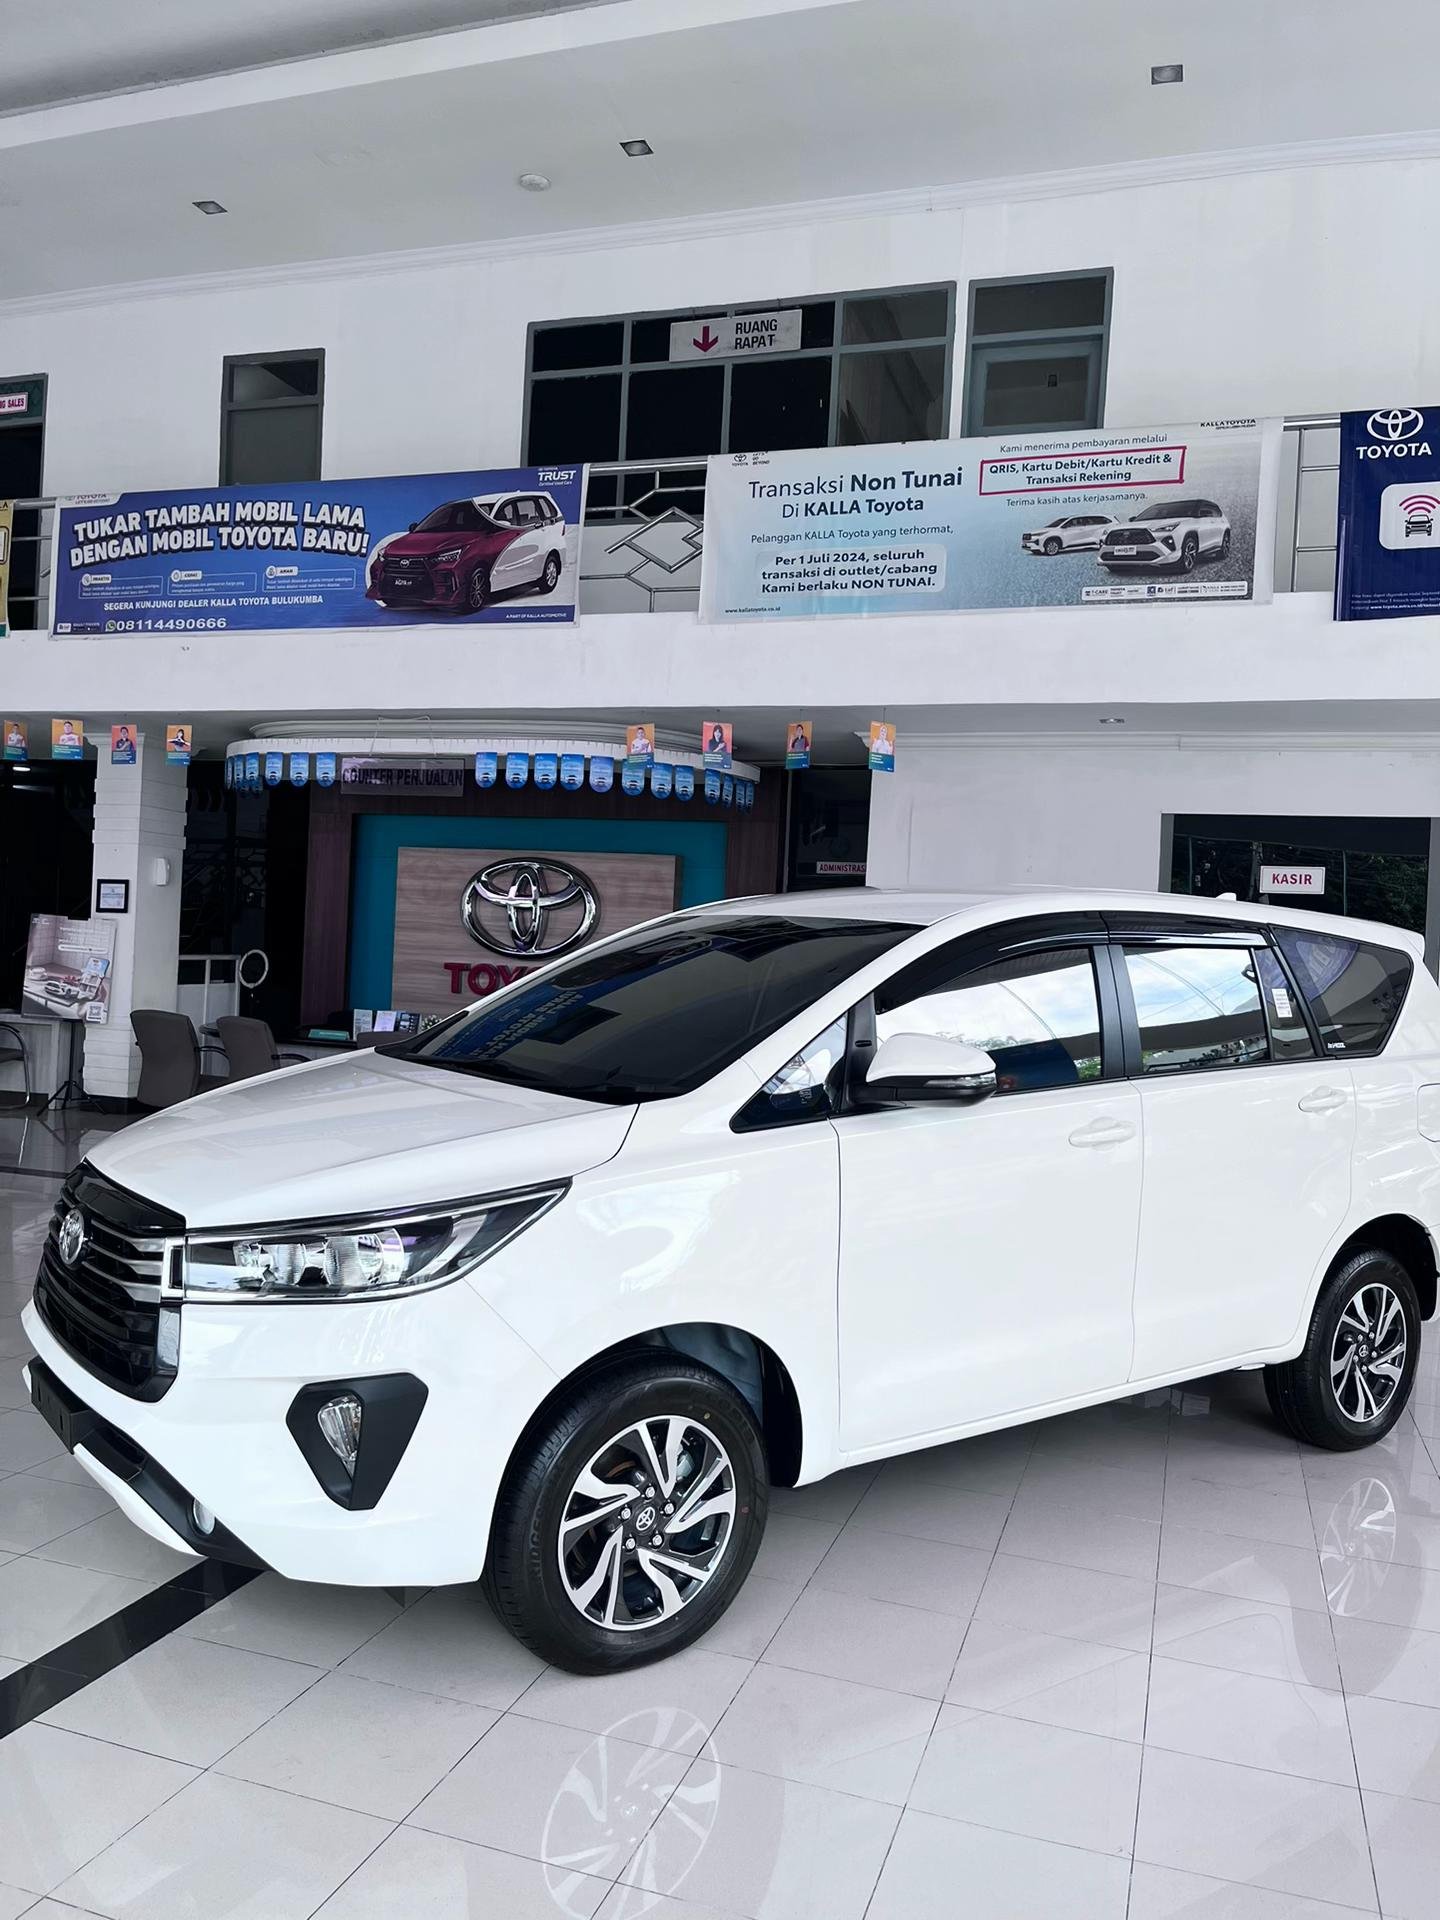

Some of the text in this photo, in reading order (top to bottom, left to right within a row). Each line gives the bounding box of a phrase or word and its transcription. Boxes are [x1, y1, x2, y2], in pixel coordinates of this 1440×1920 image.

[736, 319, 778, 335] RUANG
[734, 334, 776, 349] RAPAT
[8, 397, 25, 408] SALES
[1000, 433, 1167, 453] Kami menerima pembayaran melalui
[1355, 442, 1432, 459] TOYOTA
[989, 453, 1172, 475] QRIS, Kartu Debit/Kartu Kredit &
[538, 470, 577, 481] TRUST
[749, 467, 963, 499] Transaksi Non Tunai
[1026, 470, 1132, 485] Transaksi Rekening
[782, 497, 924, 518] Di KALLA Toyota
[1006, 492, 1148, 507] Terima kasih atas kerjasamanya.
[74, 501, 365, 542] TUKAR TAMBAH MOBIL LAMA
[751, 524, 954, 544] Pelanggan KALLA Toyota yang terhormat,
[70, 526, 370, 567] DENGAN MOBIL TOYOTA BARU!
[775, 549, 925, 566] Per 1 Juli 2024, seluruh
[761, 564, 938, 580] transaksi di outlet/cabang
[761, 576, 936, 593] Kami berlaku NON TUNAI.
[104, 595, 323, 611] SEGERA KUNJUNGI DEALER KALLA TOYOTA BULUKUMBA
[116, 617, 227, 630] 08114490666
[342, 767, 463, 786] COUNTER PENJUALAN
[1271, 873, 1312, 885] KASIR
[443, 963, 542, 996] TOY
